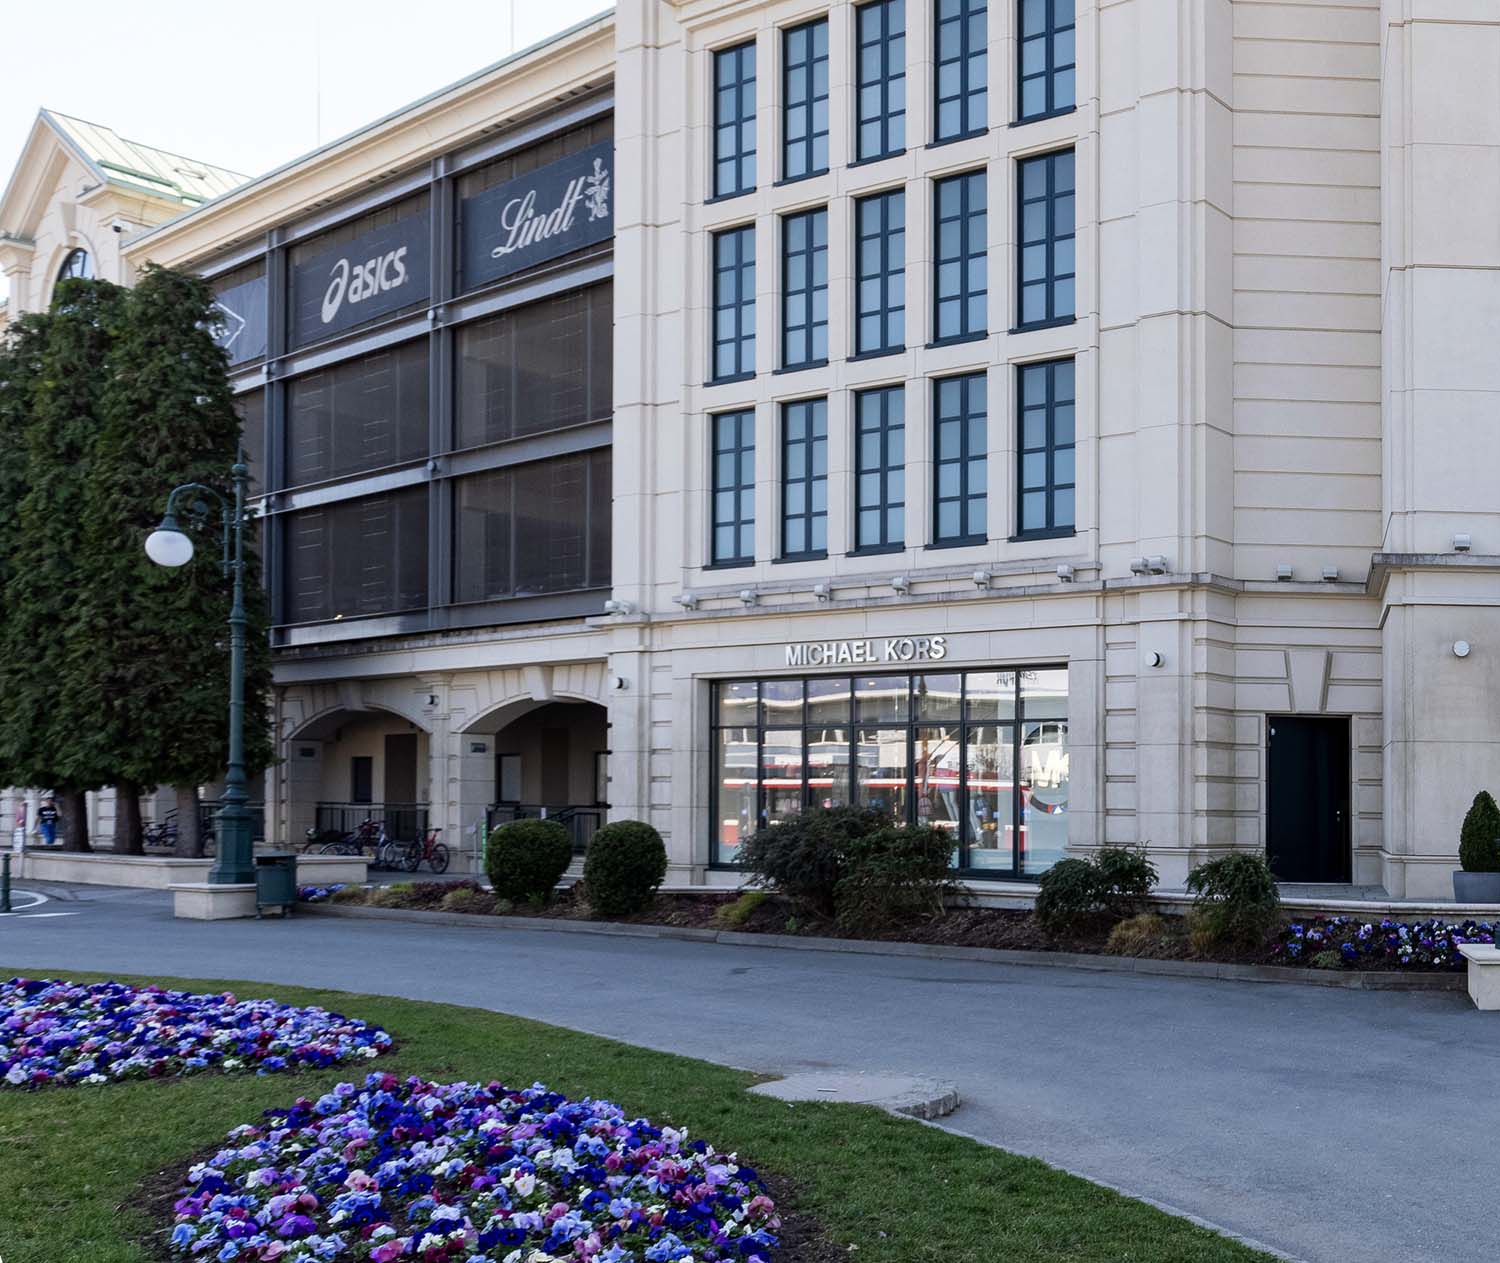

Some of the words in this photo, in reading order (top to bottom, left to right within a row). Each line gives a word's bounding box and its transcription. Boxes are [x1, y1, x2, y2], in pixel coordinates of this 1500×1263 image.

[491, 176, 586, 258] Lindt
[785, 640, 878, 666] MICHAEL
[885, 636, 946, 661] KORS
